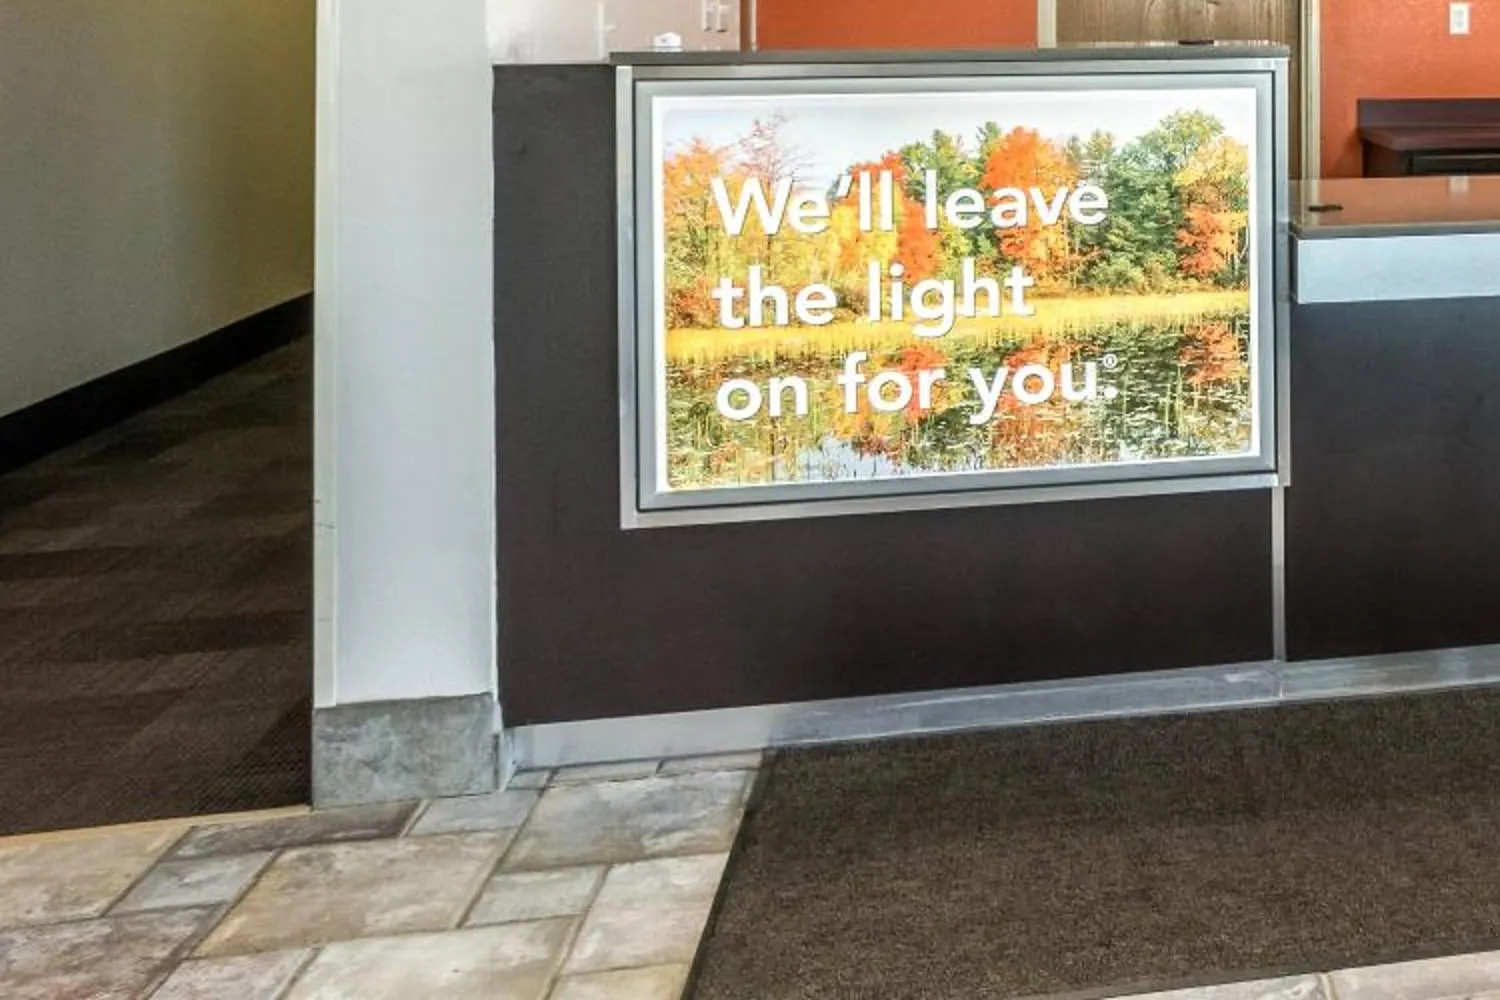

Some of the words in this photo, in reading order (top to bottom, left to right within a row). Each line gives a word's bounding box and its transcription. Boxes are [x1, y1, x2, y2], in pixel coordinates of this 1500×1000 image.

[711, 170, 894, 236] We'll
[925, 169, 1109, 228] leave
[713, 264, 837, 329] the
[868, 258, 1035, 338] light
[716, 370, 808, 420] on
[839, 351, 945, 413] for
